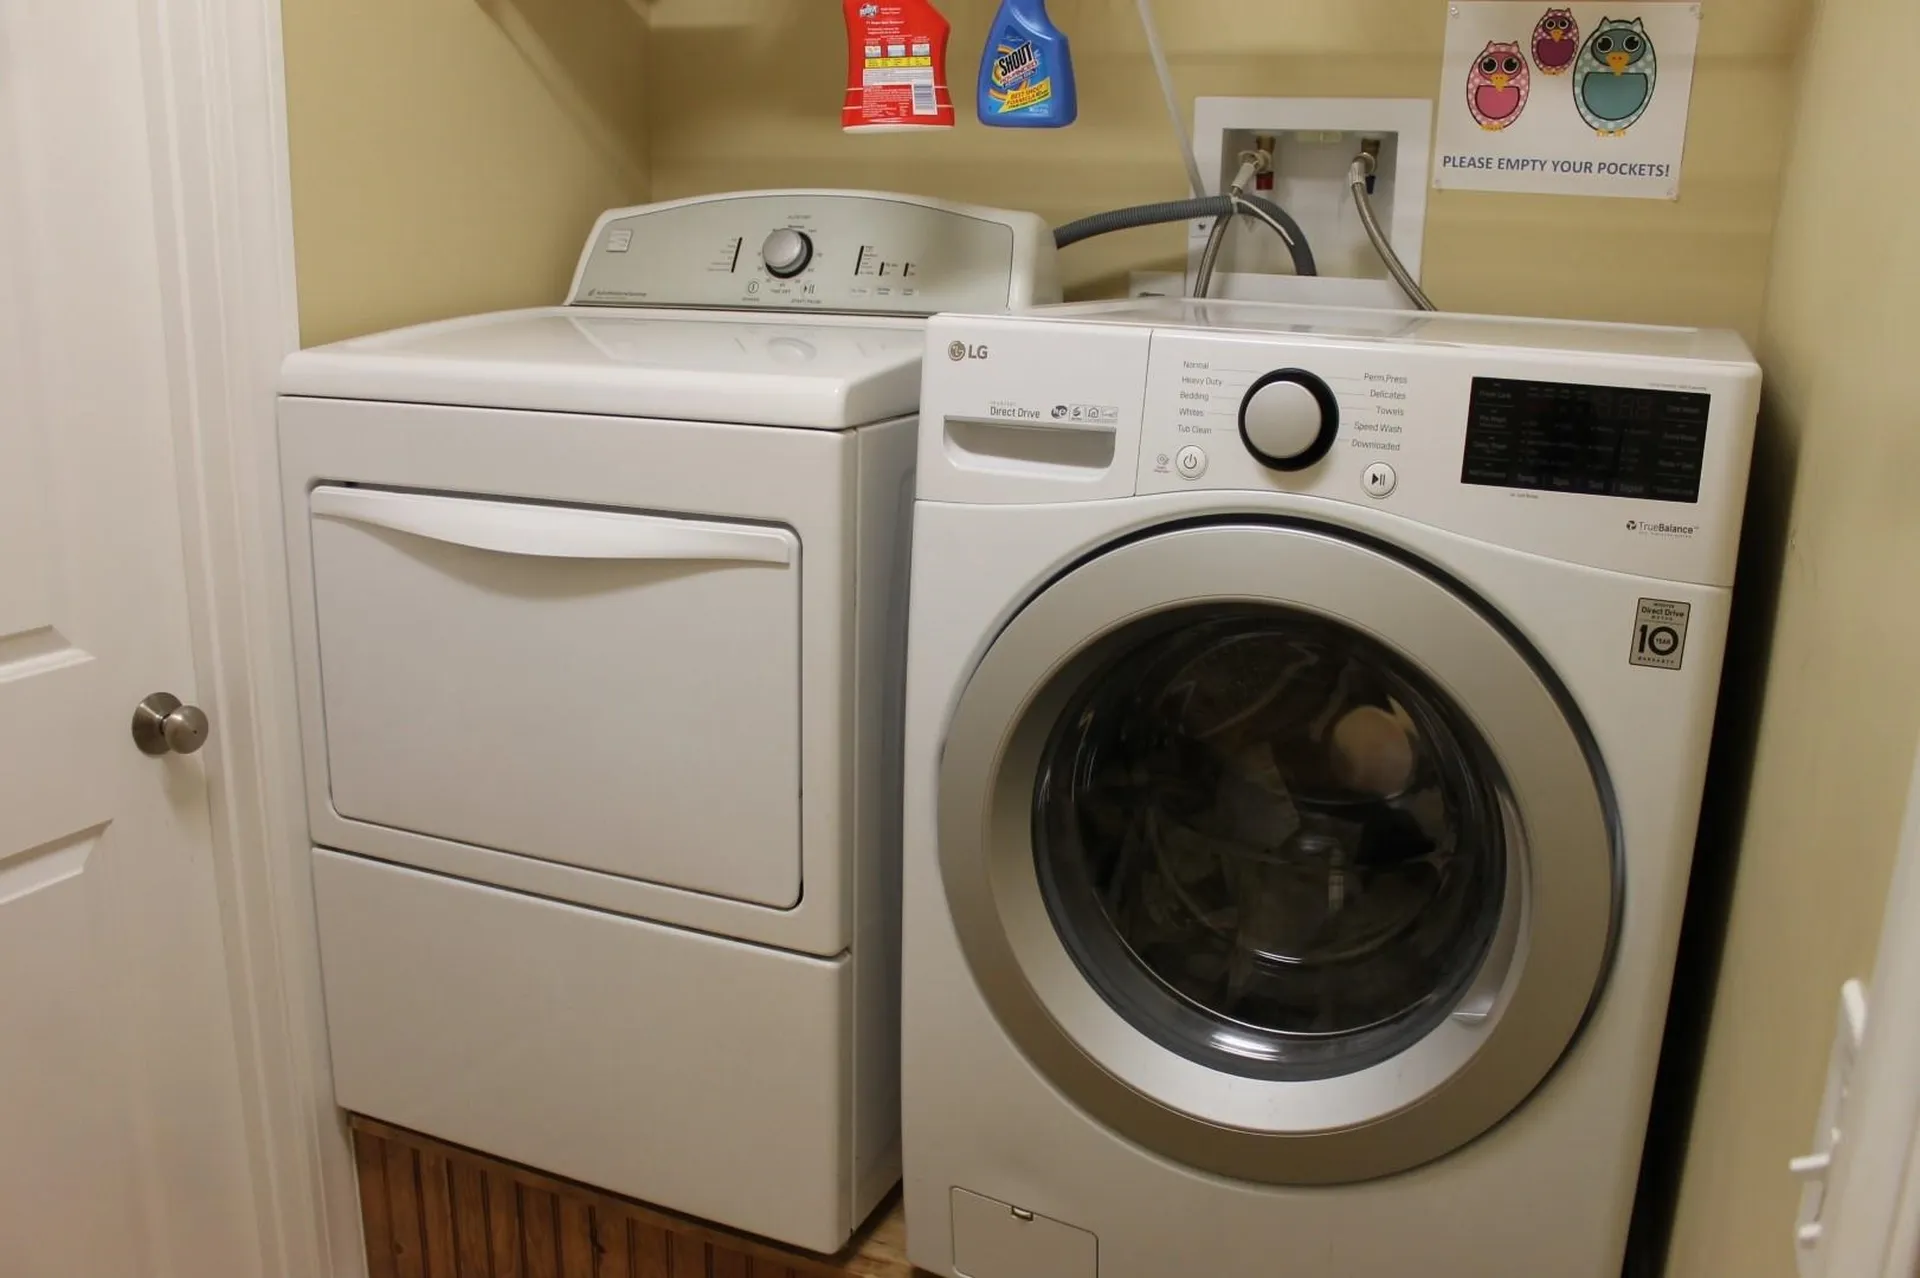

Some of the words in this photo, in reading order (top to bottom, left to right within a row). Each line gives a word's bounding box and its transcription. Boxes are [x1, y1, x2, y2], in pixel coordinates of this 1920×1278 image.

[999, 42, 1032, 76] SHOUT
[1443, 156, 1493, 169] PLEASE
[1497, 157, 1547, 171] EMPTY
[1549, 160, 1593, 174] YOUR
[1597, 162, 1670, 177] POCKETS!
[968, 344, 988, 360] LG
[1183, 360, 1209, 369] Normal
[1181, 376, 1204, 385] Heavy
[1205, 377, 1223, 387] Duty
[1180, 391, 1209, 402] Bedding
[1370, 389, 1406, 400] Delicates
[990, 406, 1016, 418] Direct
[1017, 408, 1041, 419] Drive
[1179, 407, 1204, 416] Whites
[1376, 405, 1405, 416] Towels
[1177, 423, 1191, 433] Tub
[1191, 425, 1212, 435] Clean
[1355, 421, 1379, 432] Speed
[1380, 424, 1402, 433] Wash
[1351, 438, 1400, 451] Downloaded
[1638, 521, 1694, 534] TrueBalance
[1641, 606, 1663, 615] Direct
[1664, 609, 1684, 617] Drive
[1638, 624, 1679, 656] 10
